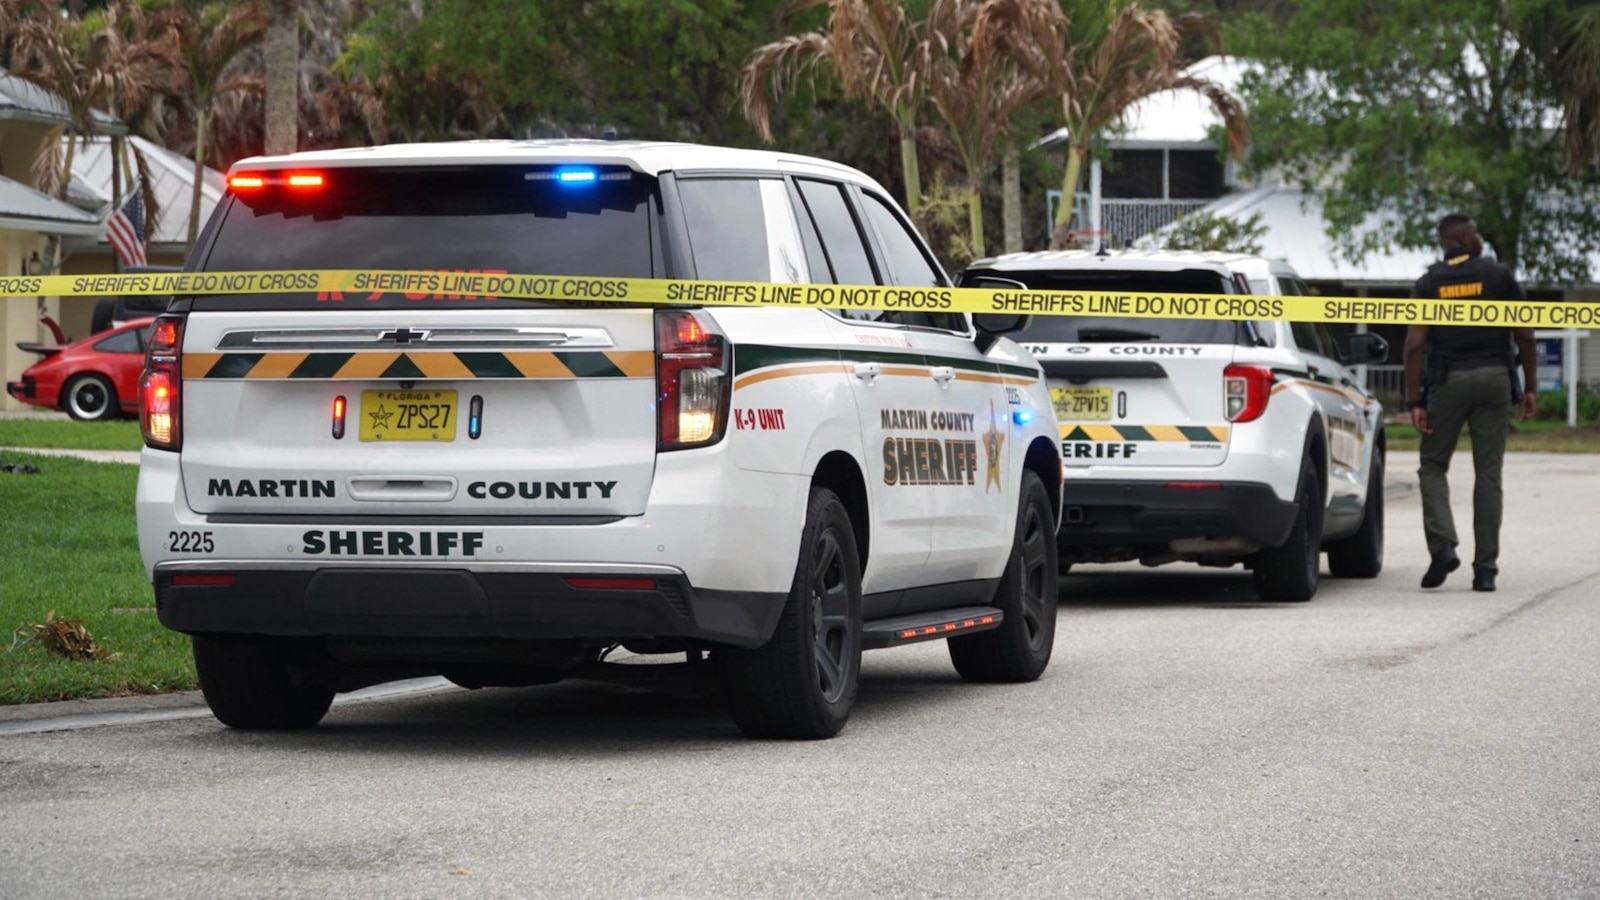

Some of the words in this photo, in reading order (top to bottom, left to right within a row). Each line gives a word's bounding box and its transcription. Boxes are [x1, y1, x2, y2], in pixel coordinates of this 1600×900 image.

[0, 279, 41, 293] ROSS
[73, 277, 151, 292] SHERIFFS
[152, 276, 190, 291] LINE
[191, 275, 217, 291] DO
[220, 274, 257, 290] NOT
[259, 273, 320, 289] CROSS
[353, 273, 440, 290] SHERIFFS
[442, 276, 489, 292] LINE
[486, 277, 516, 294] DO
[518, 278, 560, 295] NOT
[562, 279, 629, 298] CROSS
[1438, 281, 1483, 299] SHERIFF
[666, 283, 757, 302] SHERIFFS
[760, 286, 803, 304] LINE
[806, 287, 835, 305] DO
[839, 288, 881, 306] NOT
[884, 290, 952, 309] CROSS
[991, 292, 1085, 312] SHERIFFS
[1088, 295, 1131, 313] LINE
[1135, 296, 1165, 314] DO
[1169, 297, 1212, 315] NOT
[1214, 298, 1284, 317] CROSS
[1323, 300, 1418, 320] SHERIFFS
[1421, 303, 1465, 321] LINE
[1469, 304, 1499, 322] DO
[1503, 305, 1546, 323] NOT
[1549, 306, 1600, 325] CROS
[1108, 345, 1203, 355] COUNTY
[386, 392, 431, 401] FLORIDA
[1072, 395, 1109, 413] ZPV15
[396, 404, 451, 429] ZPS27
[734, 408, 756, 430] K-9
[757, 408, 786, 430] UNIT
[880, 408, 928, 430] MARTIN
[930, 409, 975, 432] COUNTY
[882, 436, 978, 486] SHERIFF
[1062, 442, 1137, 458] ERIFF
[208, 478, 336, 498] MARTIN
[467, 480, 619, 499] COUNTY
[168, 530, 215, 553] 2225
[302, 530, 484, 556] SHERIFF
